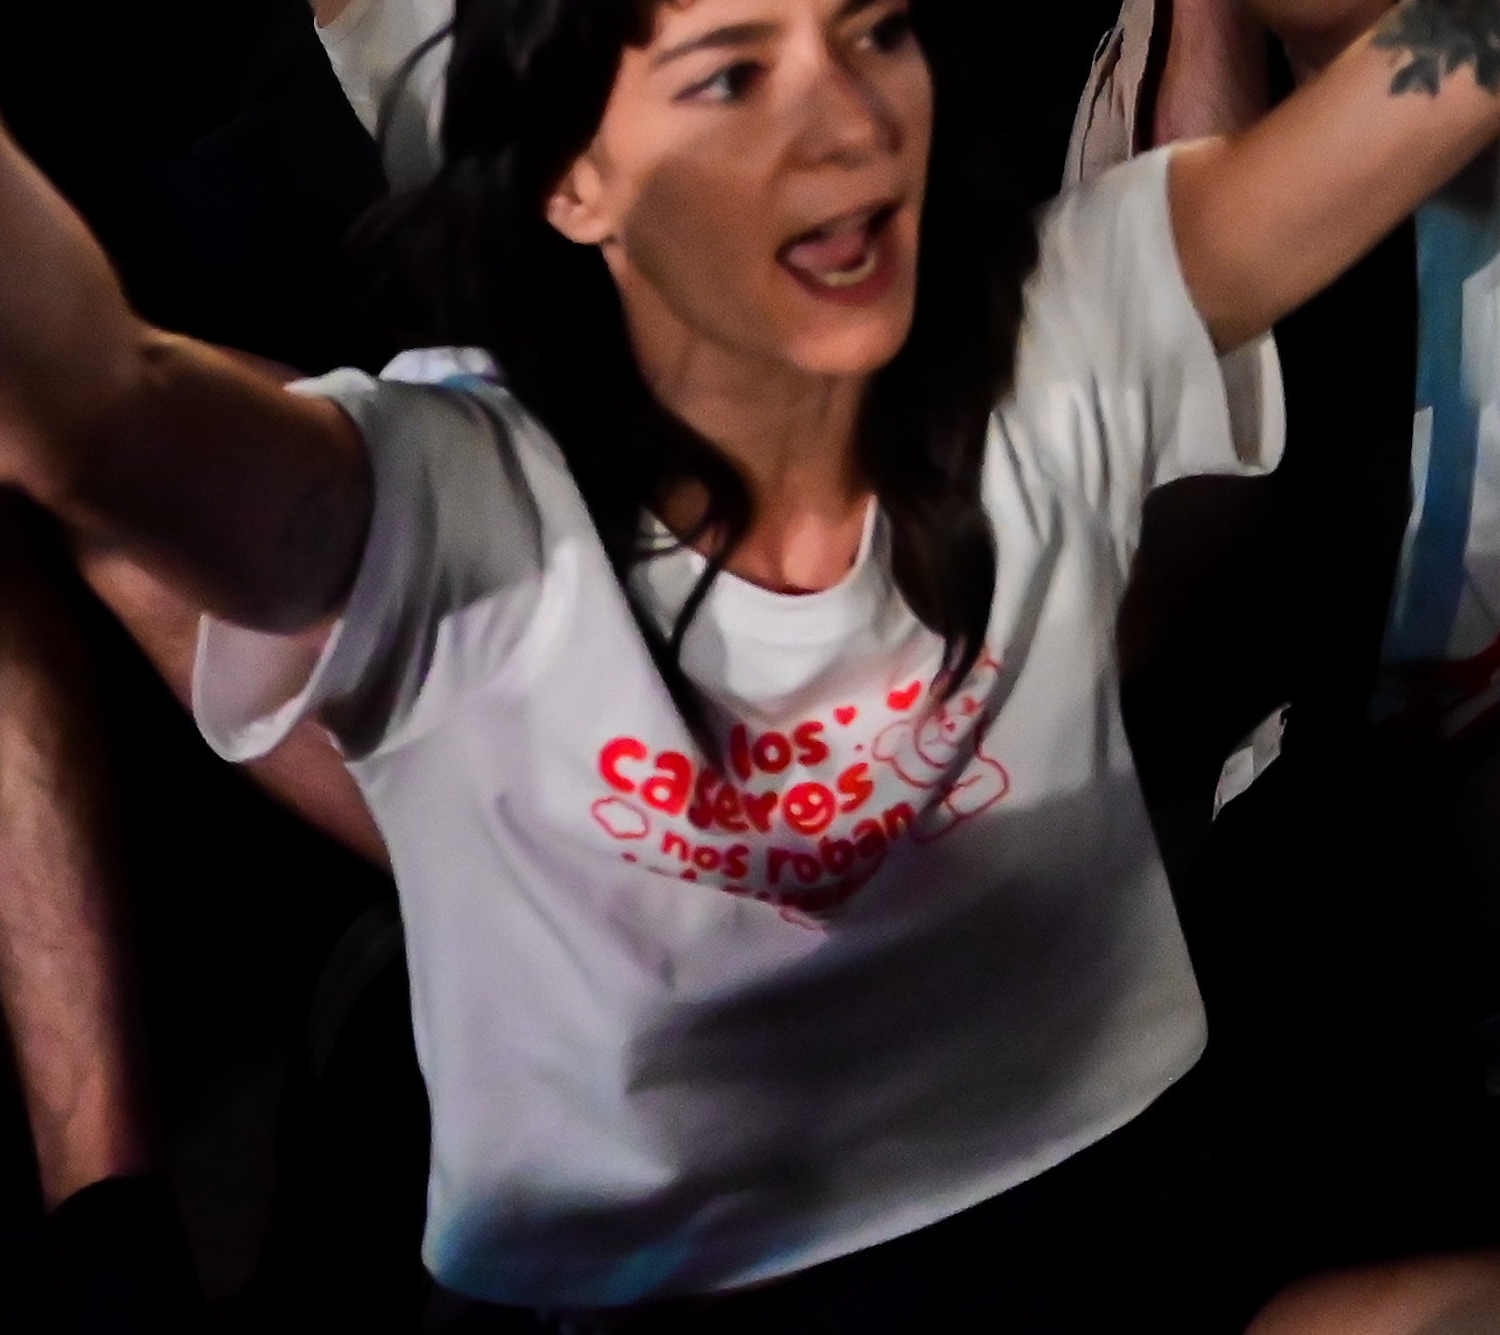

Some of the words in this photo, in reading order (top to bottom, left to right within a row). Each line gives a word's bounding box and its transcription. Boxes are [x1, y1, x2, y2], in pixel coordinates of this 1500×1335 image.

[728, 720, 831, 781] los
[660, 829, 750, 879] nos
[766, 801, 917, 885] roban
